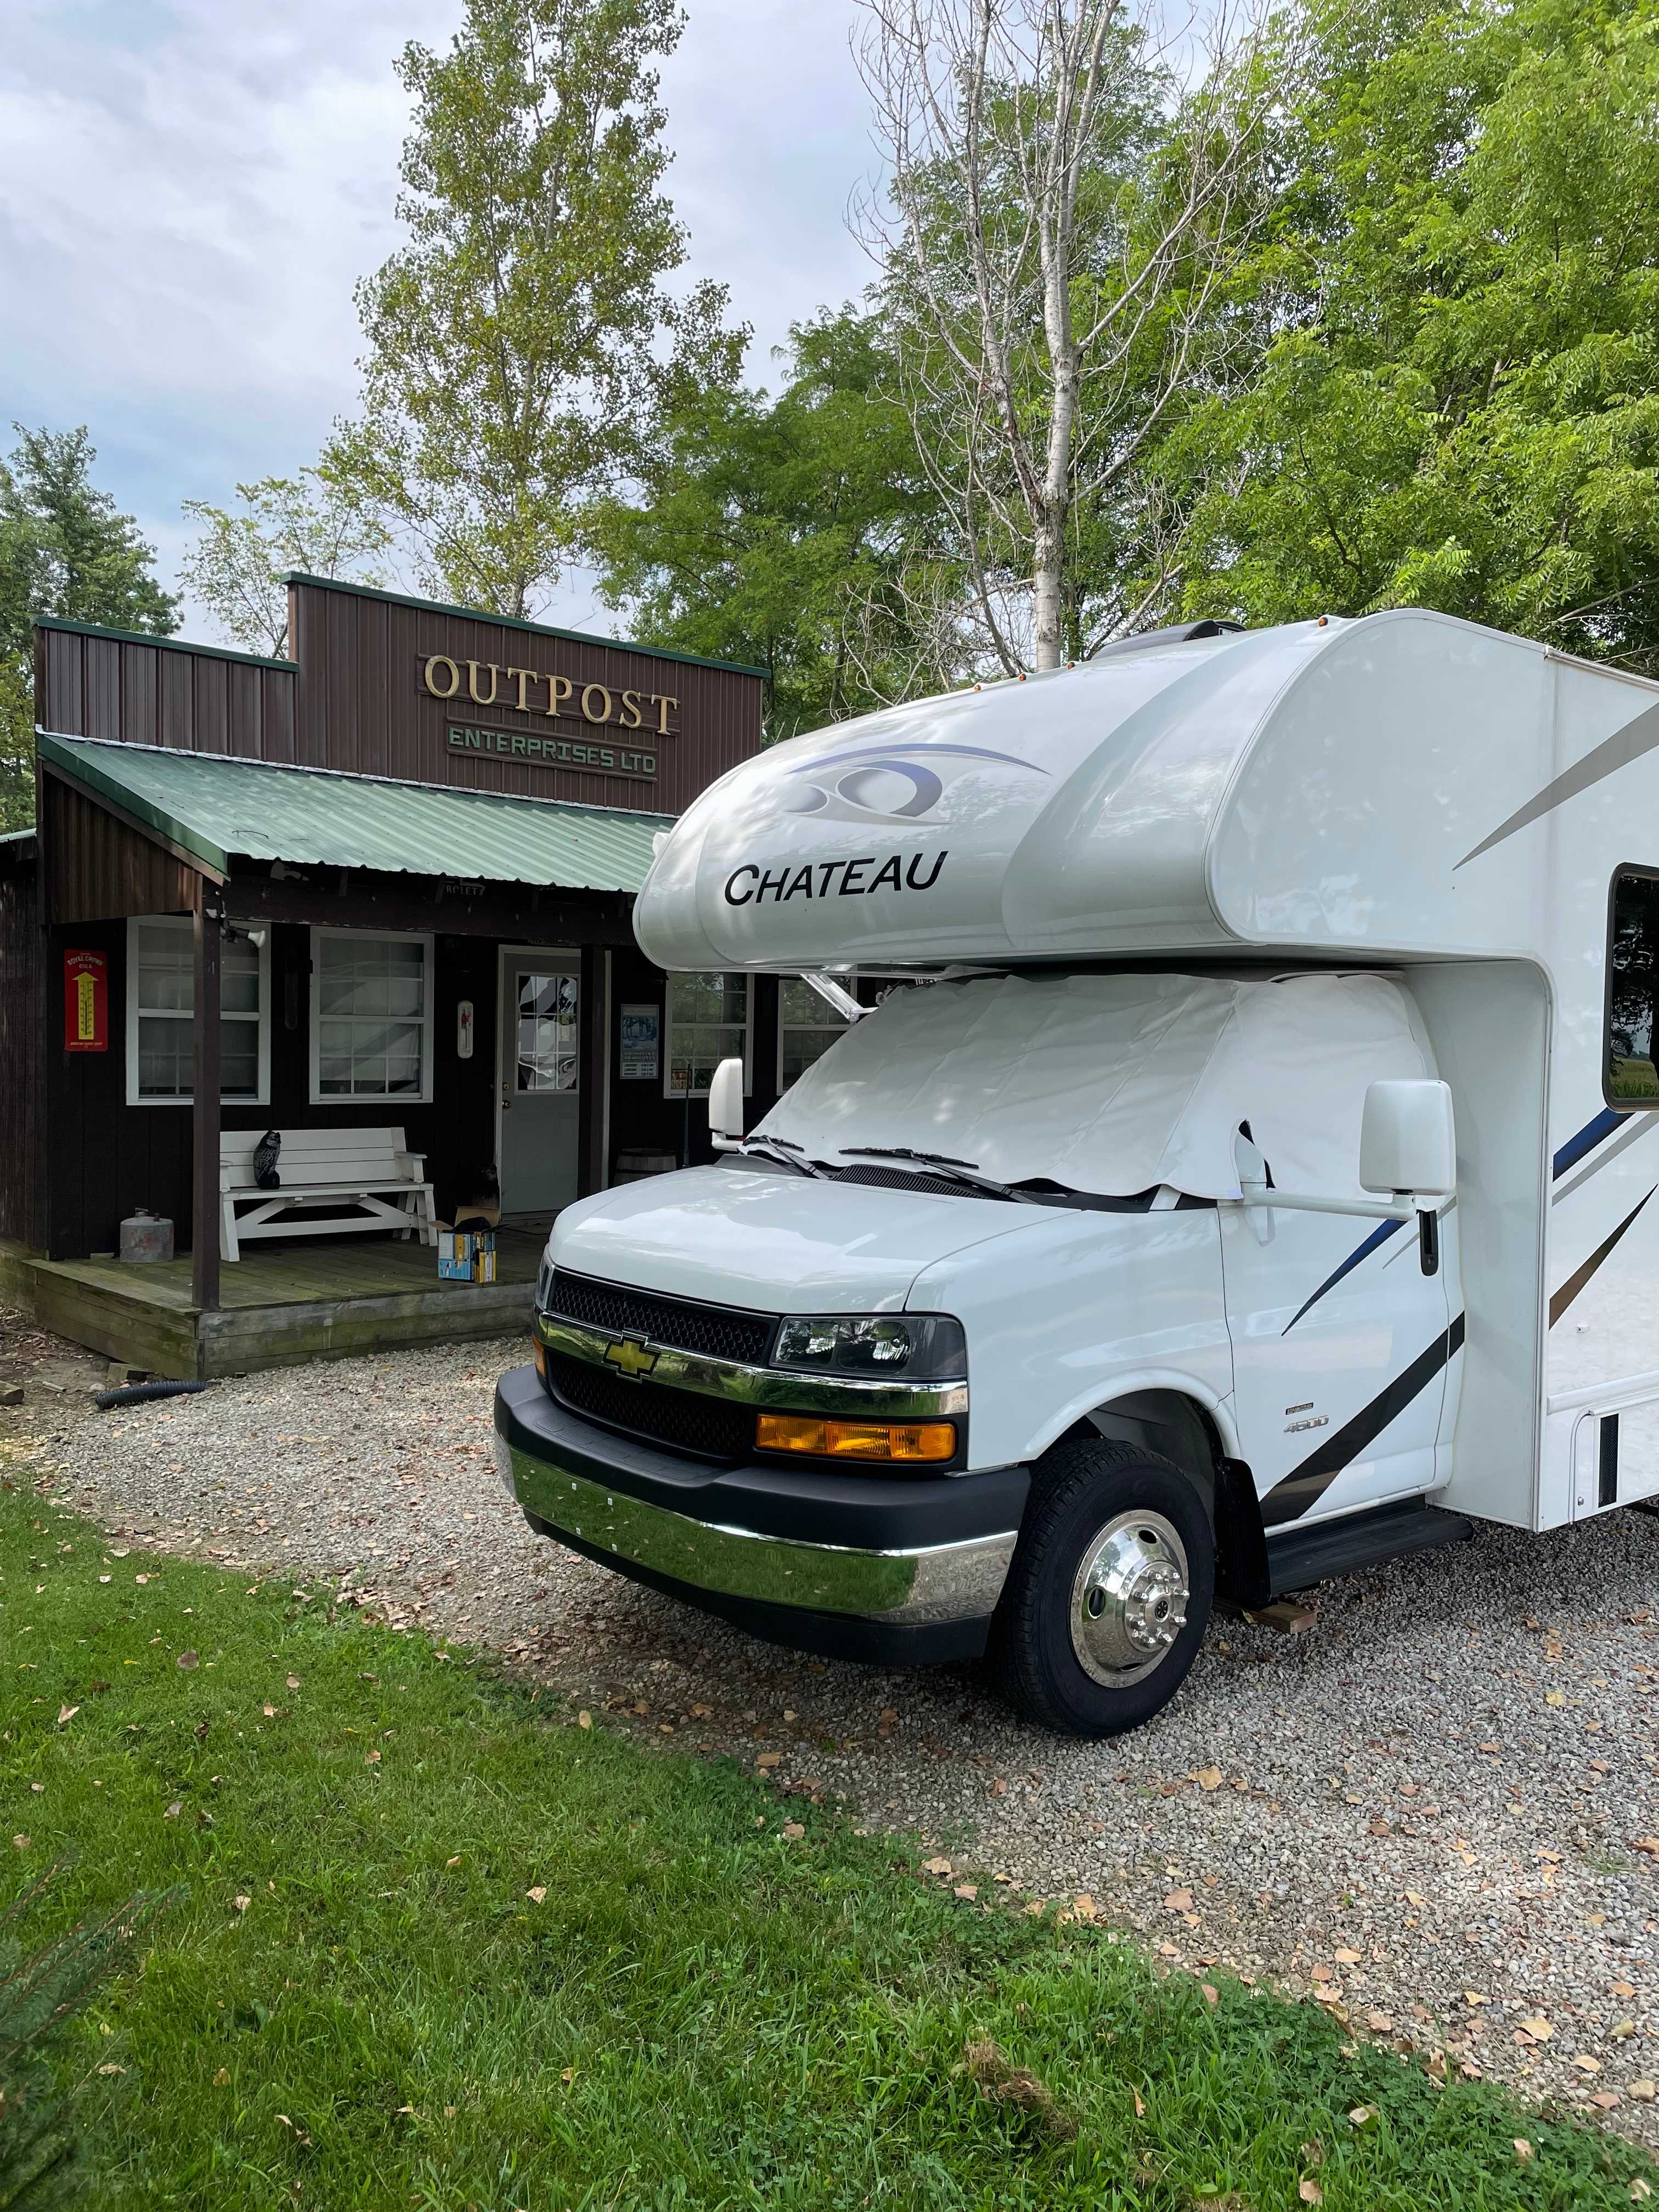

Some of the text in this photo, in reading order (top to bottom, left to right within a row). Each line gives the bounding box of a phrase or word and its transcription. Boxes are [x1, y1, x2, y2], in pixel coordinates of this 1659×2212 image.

[425, 654, 678, 735] OUTPOST
[449, 727, 656, 774] ENTERPRISES LTD
[725, 851, 949, 906] CHATEAU
[66, 955, 84, 966] ROYAL
